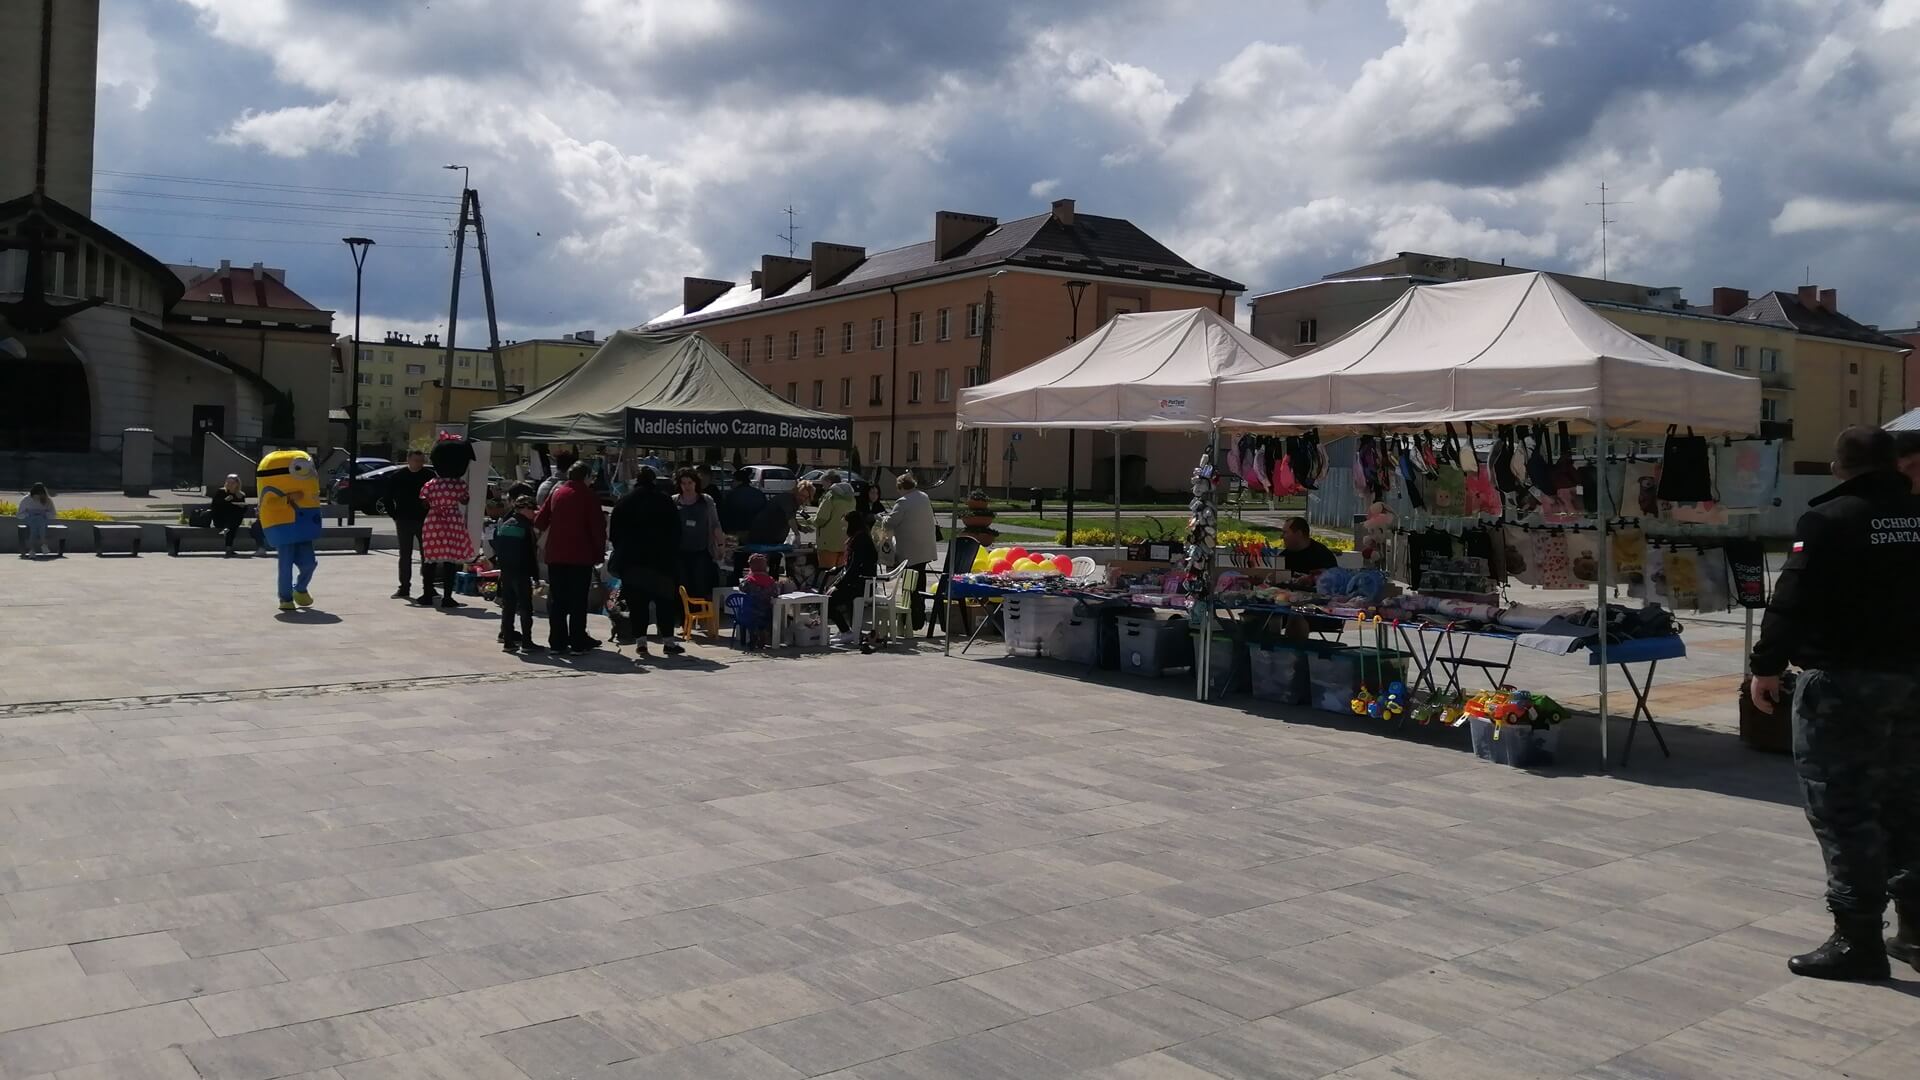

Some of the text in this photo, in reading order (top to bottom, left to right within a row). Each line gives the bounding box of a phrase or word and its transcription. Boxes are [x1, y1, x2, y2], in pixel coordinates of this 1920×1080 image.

[634, 417, 847, 441] Nadleśnictwo Czarna Białostocka
